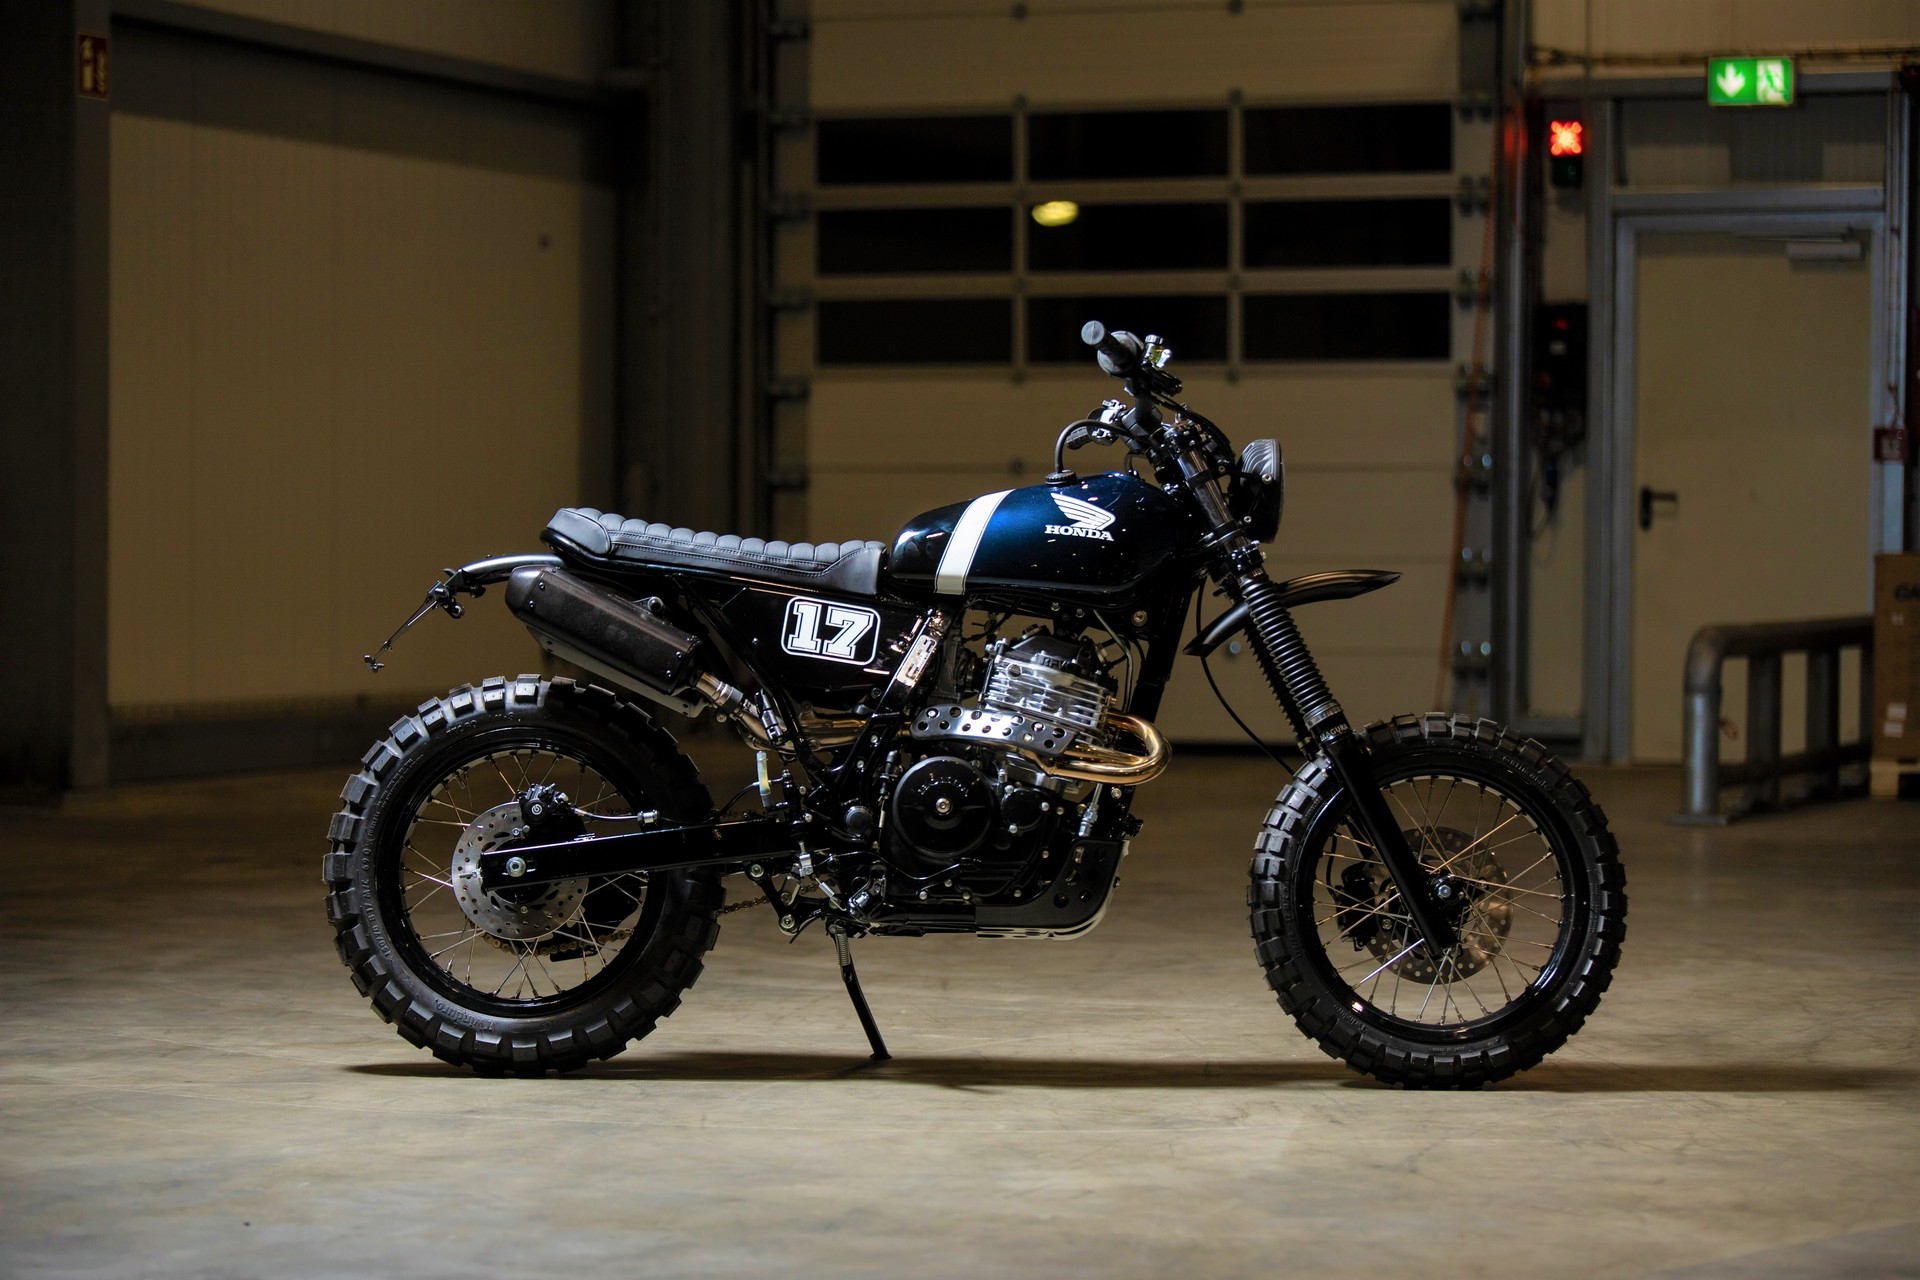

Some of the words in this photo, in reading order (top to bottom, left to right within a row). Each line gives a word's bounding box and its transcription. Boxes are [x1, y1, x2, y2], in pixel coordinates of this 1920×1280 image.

[1044, 525, 1114, 541] HONDA
[787, 601, 875, 659] 17
[1320, 723, 1349, 741] MAGURA
